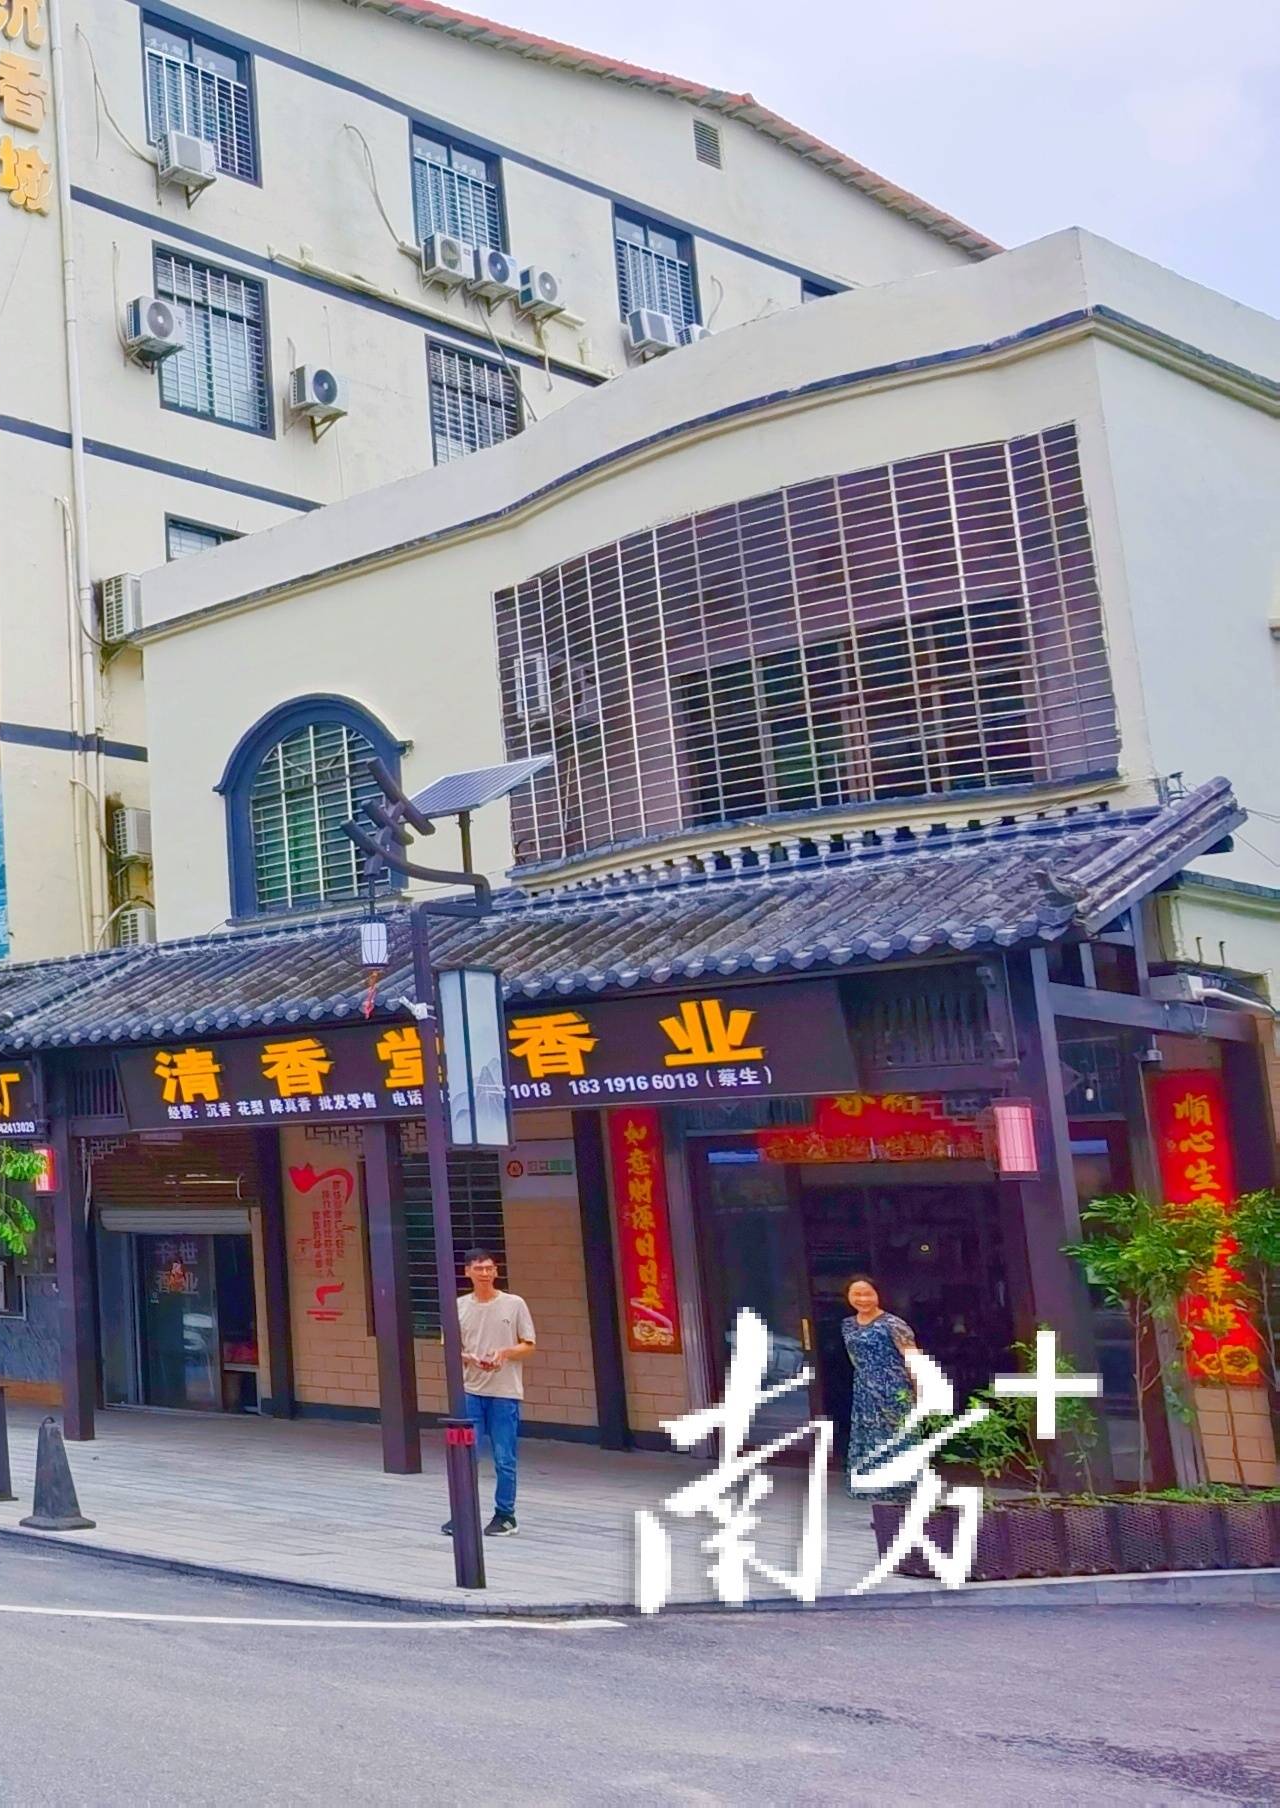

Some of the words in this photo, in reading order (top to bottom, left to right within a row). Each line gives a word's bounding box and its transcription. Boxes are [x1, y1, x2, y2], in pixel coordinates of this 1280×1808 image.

[154, 998, 766, 1104] 清香堂香业
[205, 1102, 232, 1119] 沉香
[236, 1100, 266, 1116] 花梨
[269, 1098, 313, 1115] 降真香
[318, 1092, 378, 1112] 批发零售
[568, 1078, 601, 1097] 183
[604, 1075, 650, 1094] 1916
[652, 1072, 699, 1091] 6018
